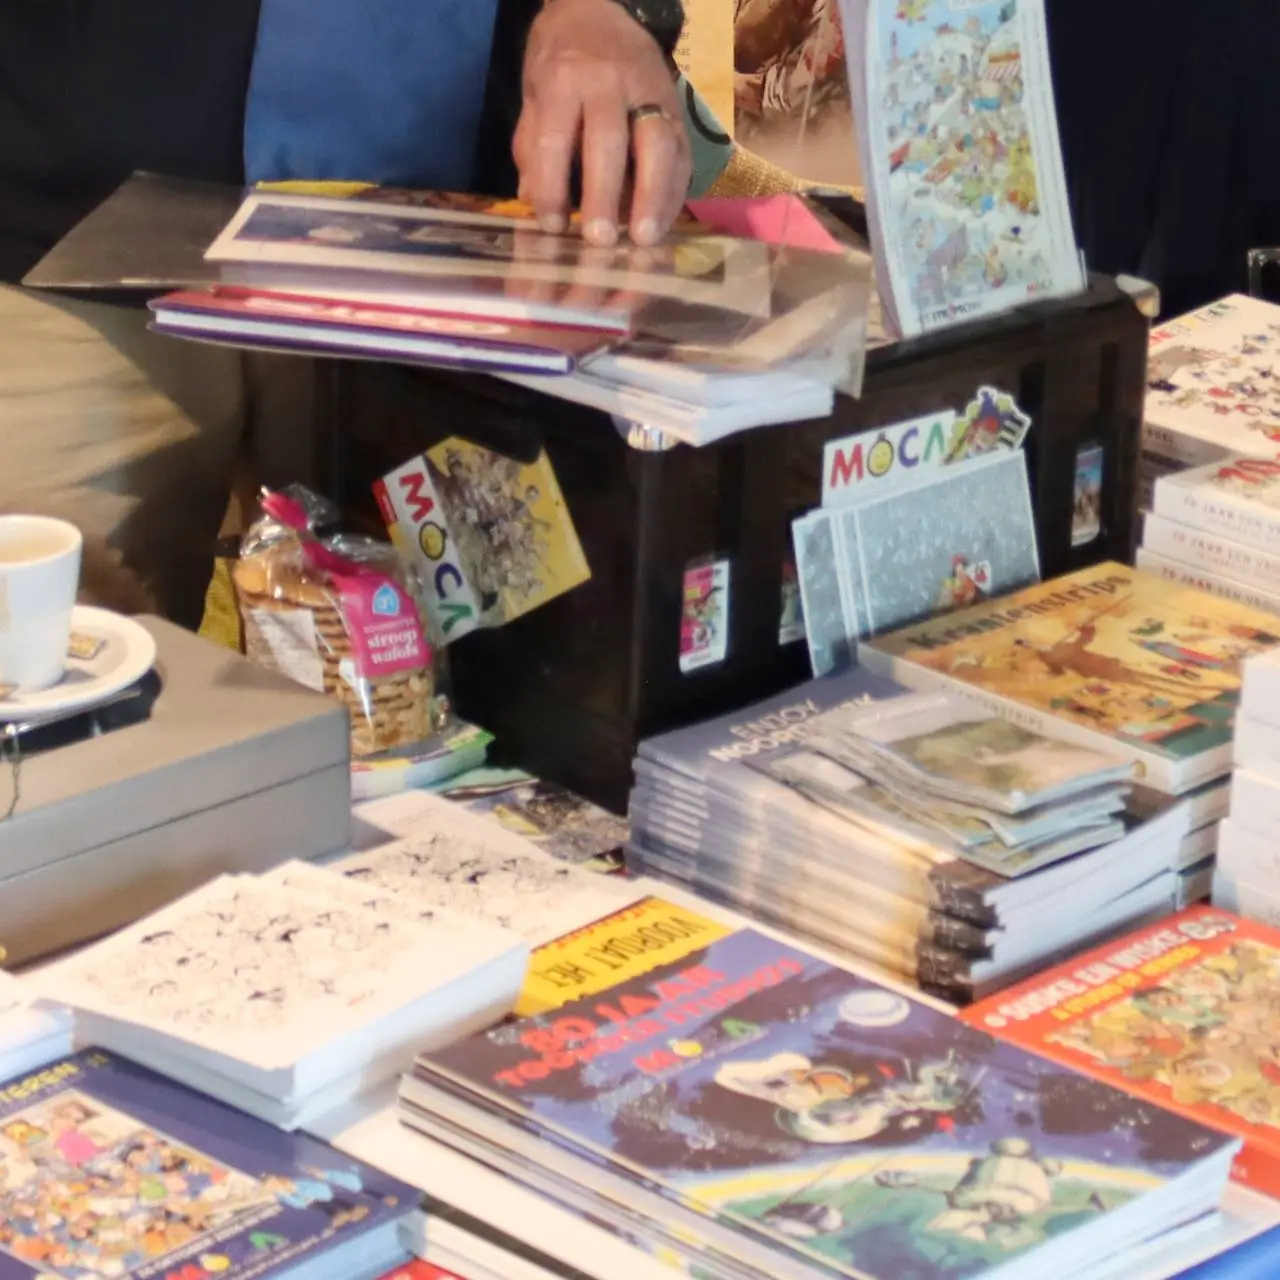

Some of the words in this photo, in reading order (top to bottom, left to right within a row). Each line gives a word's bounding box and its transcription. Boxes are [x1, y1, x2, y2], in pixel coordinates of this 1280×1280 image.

[830, 422, 945, 488] MOCA
[367, 629, 418, 649] stroop
[371, 644, 419, 665] wafels
[595, 963, 727, 1022] JAAR
